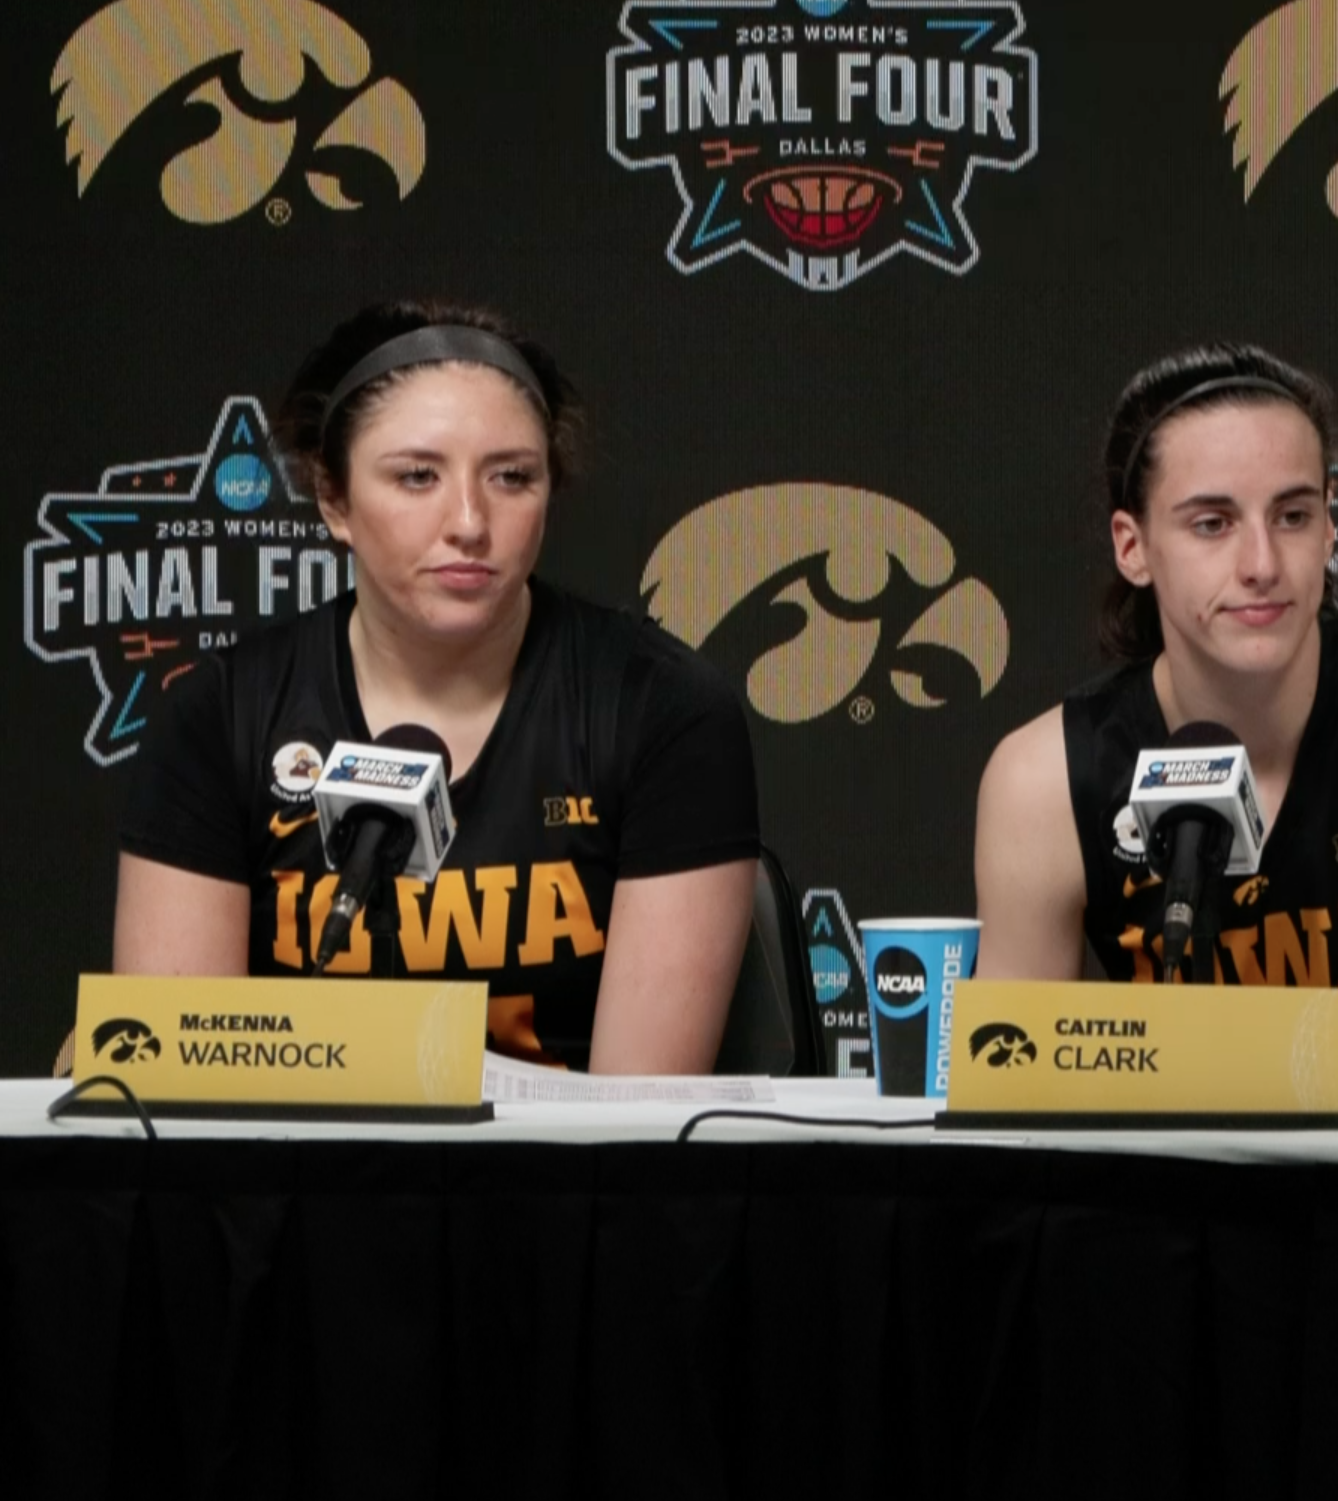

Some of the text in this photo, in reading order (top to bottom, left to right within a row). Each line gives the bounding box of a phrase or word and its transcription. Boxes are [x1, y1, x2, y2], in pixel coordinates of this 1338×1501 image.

[735, 25, 909, 45] 2023 WOMEN'S
[625, 52, 1016, 140] FINAL FOUR
[778, 139, 867, 157] DALLAS
[155, 520, 329, 540] 2023 WOMEN'S
[43, 546, 355, 632] FINAL FO
[353, 757, 404, 774] MARCH
[1163, 760, 1210, 774] MARCH
[353, 770, 422, 788] MADNESS
[1166, 769, 1230, 784] MADNESS
[271, 860, 606, 976] IOWA
[876, 973, 926, 993] NCAA
[179, 1013, 294, 1033] McKENNA
[1054, 1018, 1147, 1038] CAITLIN
[178, 1040, 348, 1069] WARNOCK
[1053, 1045, 1160, 1073] CLARK
